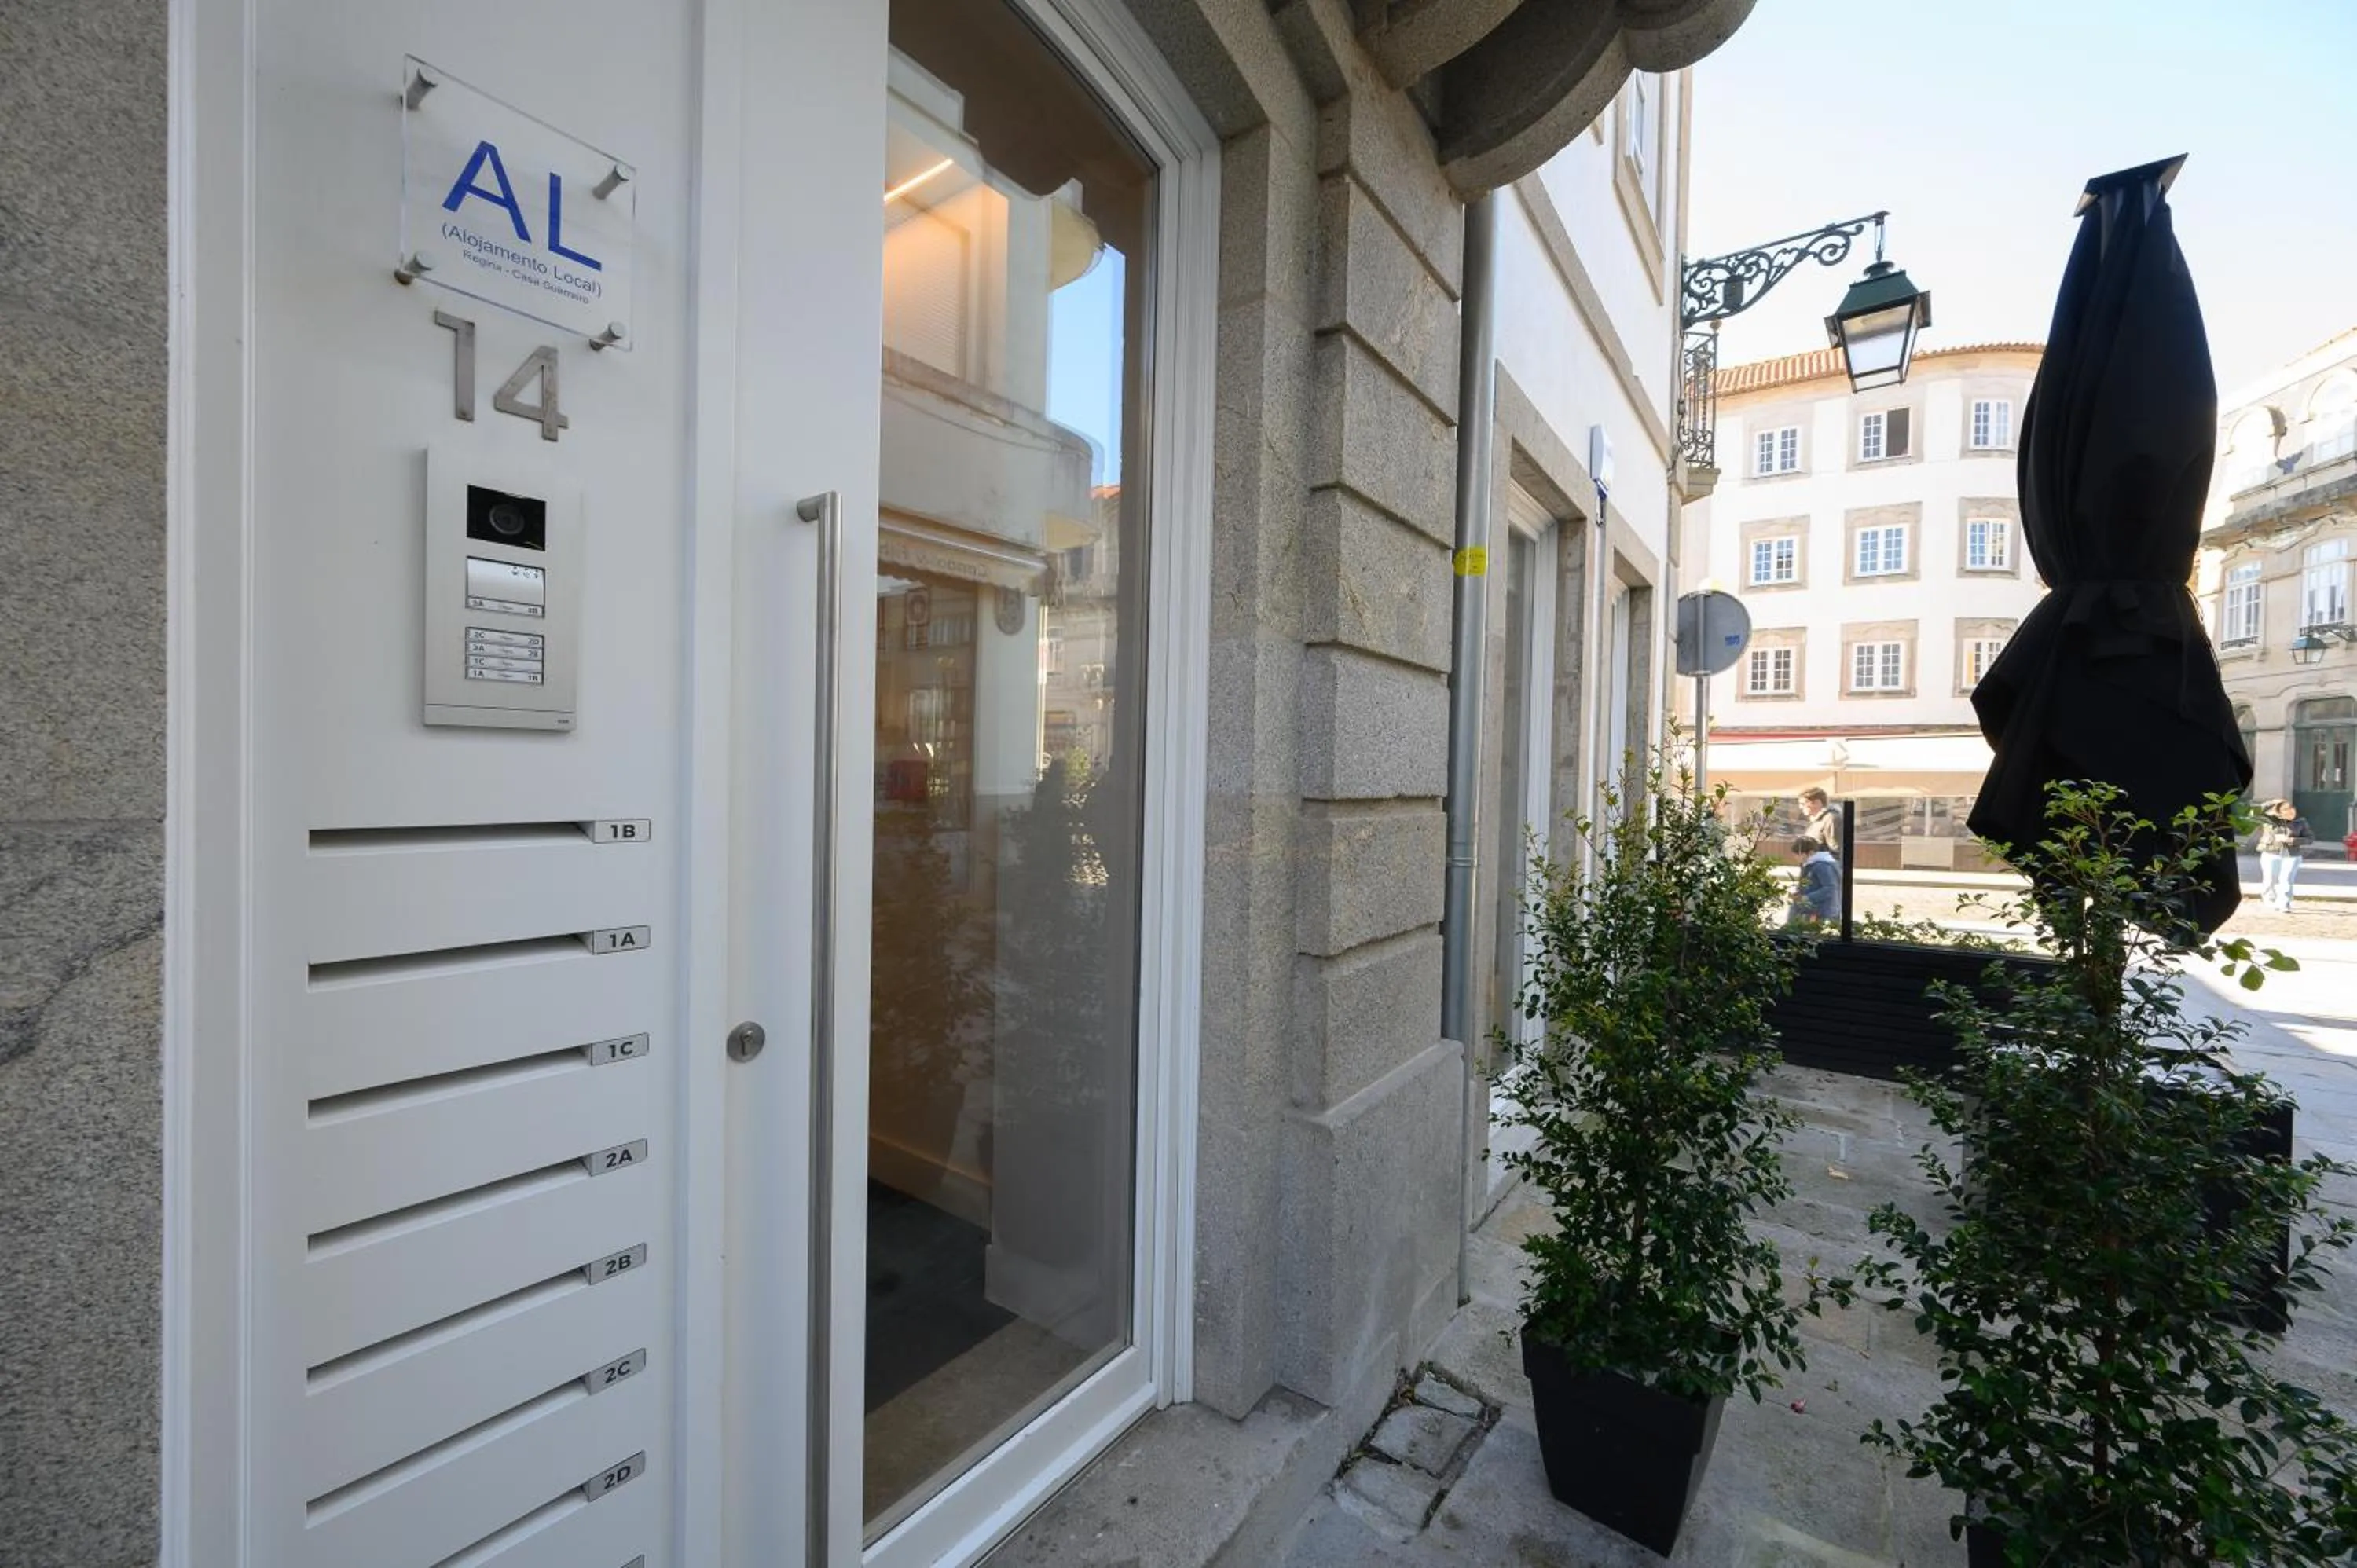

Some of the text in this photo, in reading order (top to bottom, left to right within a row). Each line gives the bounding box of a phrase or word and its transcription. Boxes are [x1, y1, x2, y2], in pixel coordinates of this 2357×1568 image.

[441, 140, 603, 271] AL
[442, 222, 601, 299] (Alojamento Local)
[511, 269, 540, 286] Casa
[434, 310, 569, 441] 14
[610, 824, 636, 839] 1B
[609, 932, 636, 947] 1A
[608, 1041, 634, 1058] 1C
[606, 1149, 632, 1168] 2A
[605, 1255, 632, 1276] 2B
[603, 1361, 631, 1383] 2C
[603, 1466, 631, 1490] 2D
